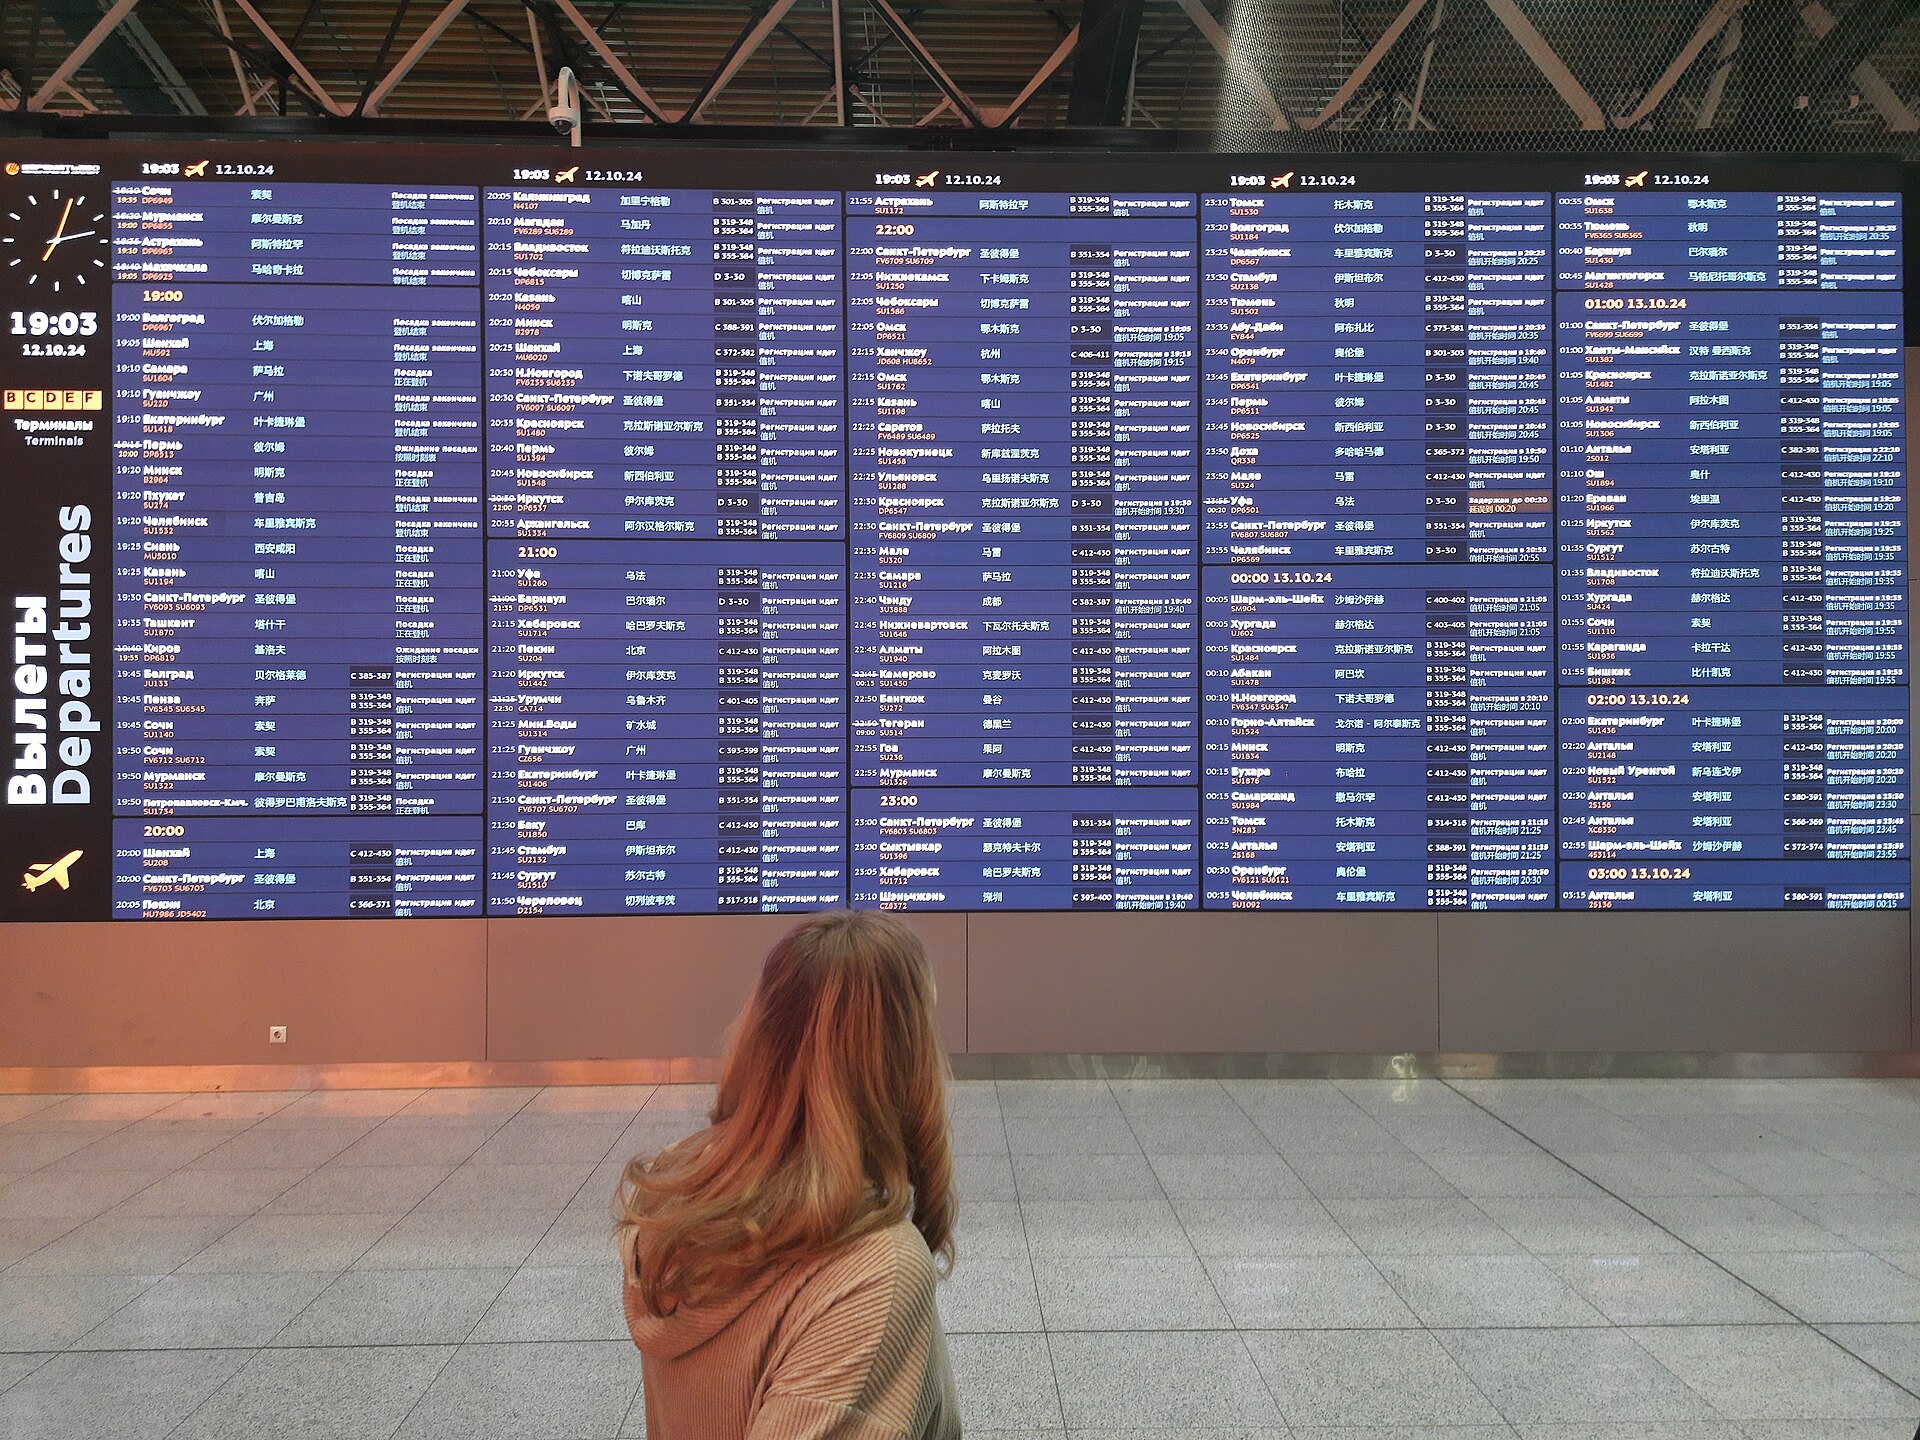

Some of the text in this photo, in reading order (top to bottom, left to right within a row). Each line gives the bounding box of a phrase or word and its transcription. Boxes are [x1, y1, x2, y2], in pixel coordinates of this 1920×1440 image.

[142, 163, 274, 174] 19:03 12.10.24
[514, 169, 642, 181] 19:03 12.10.24
[876, 174, 1001, 185] 19:03 12.10.24
[1585, 175, 1709, 184] 19:03 12.10.24
[1231, 176, 1356, 186] 19:03 12.10.24
[876, 225, 916, 237] 22:00
[144, 290, 183, 301] 19:00
[1585, 299, 1687, 311] 01:00 13.10.24
[11, 312, 97, 335] 19:03
[23, 344, 86, 356] 12.10.24
[7, 393, 93, 402] B C D E F
[14, 419, 93, 432] Терминалы
[25, 436, 83, 445] Terminals
[117, 466, 141, 474] 19:20
[144, 465, 182, 475] Минск
[517, 469, 593, 481] Новосибирск
[519, 547, 557, 557] 21:00
[879, 547, 909, 555] Мале
[1231, 545, 1291, 554] Челябинск
[1587, 544, 1624, 553] Сургут
[517, 569, 541, 581] Уфа
[762, 573, 816, 583] Регистрация
[879, 571, 921, 583] Самара
[1231, 571, 1332, 583] 00:00 13.10.24
[1587, 568, 1659, 580] Владивосток
[144, 593, 245, 605] Санкт-Петербург
[1231, 594, 1324, 607] Шарм-эль-Шейх
[143, 618, 195, 627] Ташкент
[518, 619, 580, 631] Хабаровск
[880, 621, 968, 632] Нижневартовск
[1231, 620, 1276, 630] Хургада
[1587, 618, 1614, 626] Сочи
[52, 505, 100, 803] Departures
[518, 645, 554, 653] Пекин
[1588, 643, 1646, 654] Караганда
[144, 669, 194, 682] Белград
[1231, 668, 1271, 677] Абакан
[8, 597, 47, 804] Вылеты
[880, 694, 925, 703] Бангкок
[1588, 695, 1689, 705] 02:00 13.10.24
[144, 721, 173, 729] Сочи
[518, 720, 576, 729] Мин.Воды
[1588, 716, 1664, 729] Екатеринбург
[880, 744, 898, 752] Гоа
[1588, 765, 1675, 777] Новый Уренгой
[881, 796, 917, 806] 23:00
[144, 826, 184, 836] 20:00
[1589, 868, 1690, 879] 03:00 13.10.24
